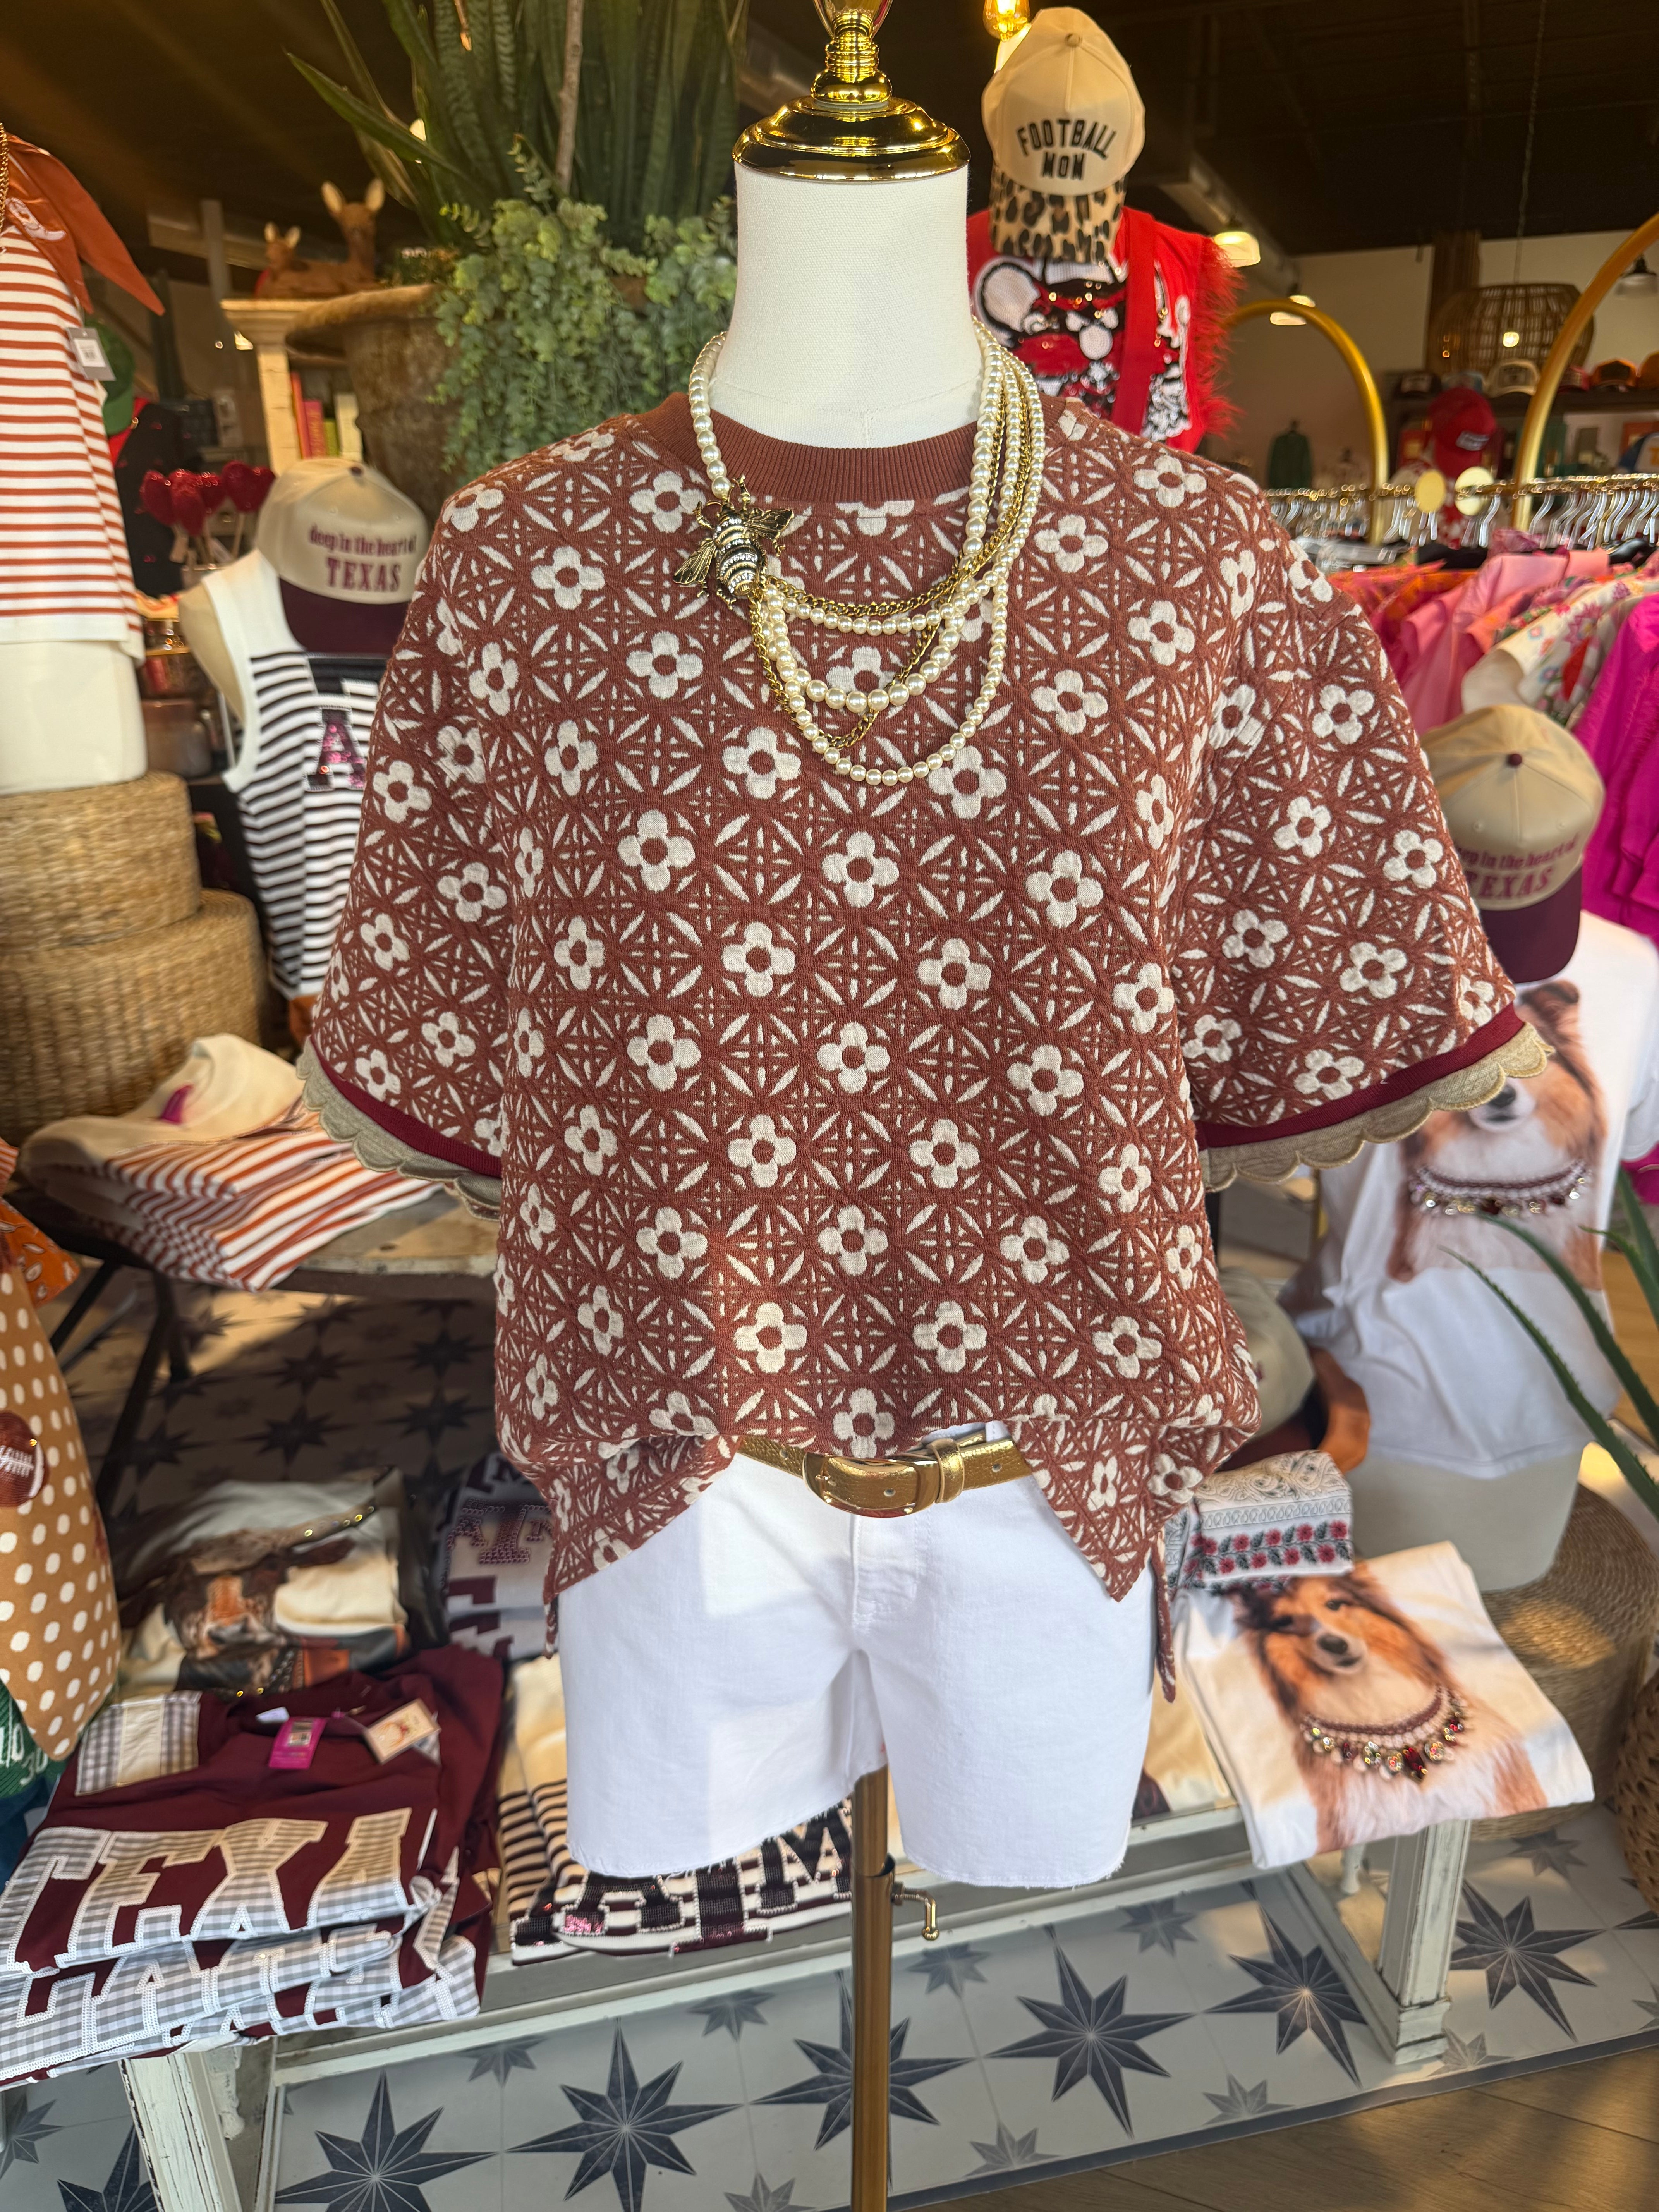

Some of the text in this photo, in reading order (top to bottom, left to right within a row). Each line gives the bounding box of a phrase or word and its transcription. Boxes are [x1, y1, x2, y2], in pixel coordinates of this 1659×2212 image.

[1017, 119, 1116, 159] FOOTBALL
[1042, 152, 1085, 180] MOM
[326, 556, 402, 592] TEXAS
